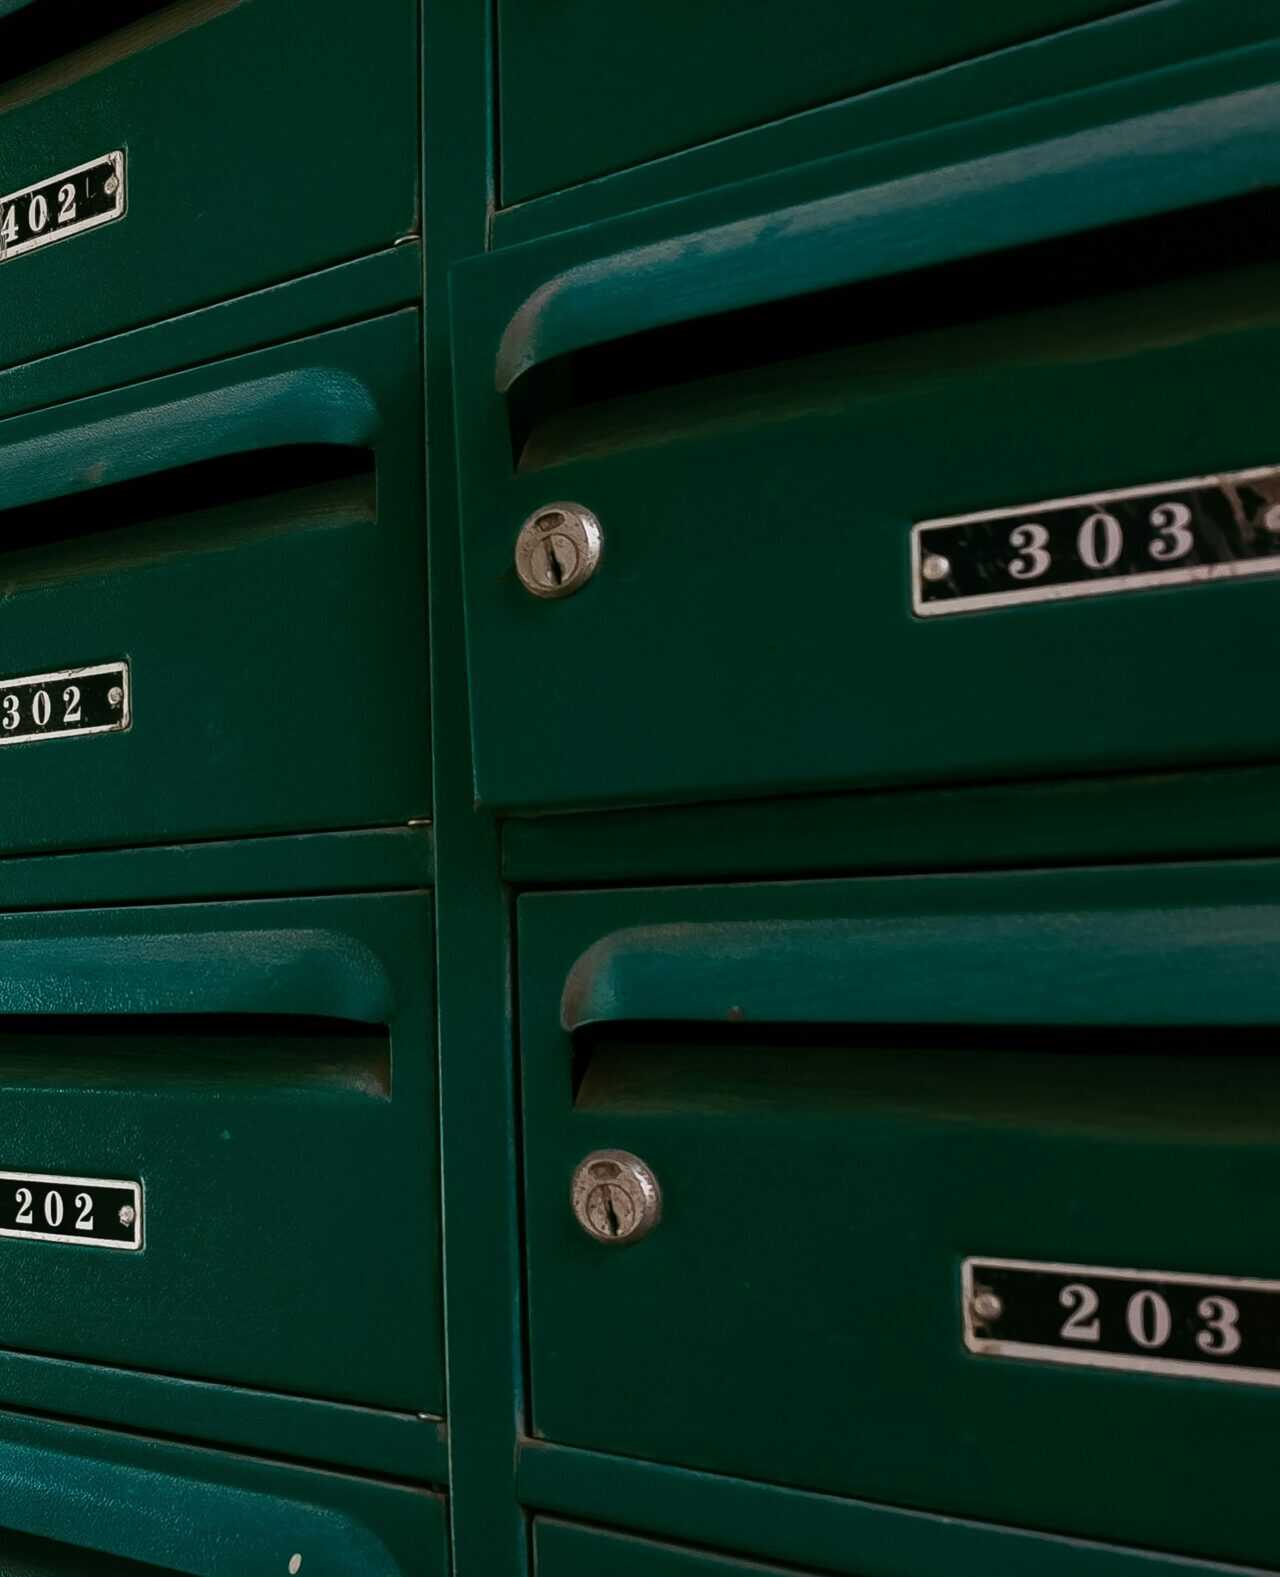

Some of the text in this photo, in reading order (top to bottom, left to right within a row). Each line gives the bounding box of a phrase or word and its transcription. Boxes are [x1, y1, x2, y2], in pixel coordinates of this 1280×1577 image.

[1, 182, 78, 241] 402
[1006, 501, 1194, 579] 303
[3, 687, 83, 729] 302
[14, 1188, 96, 1230] 202
[1058, 1282, 1243, 1356] 203
